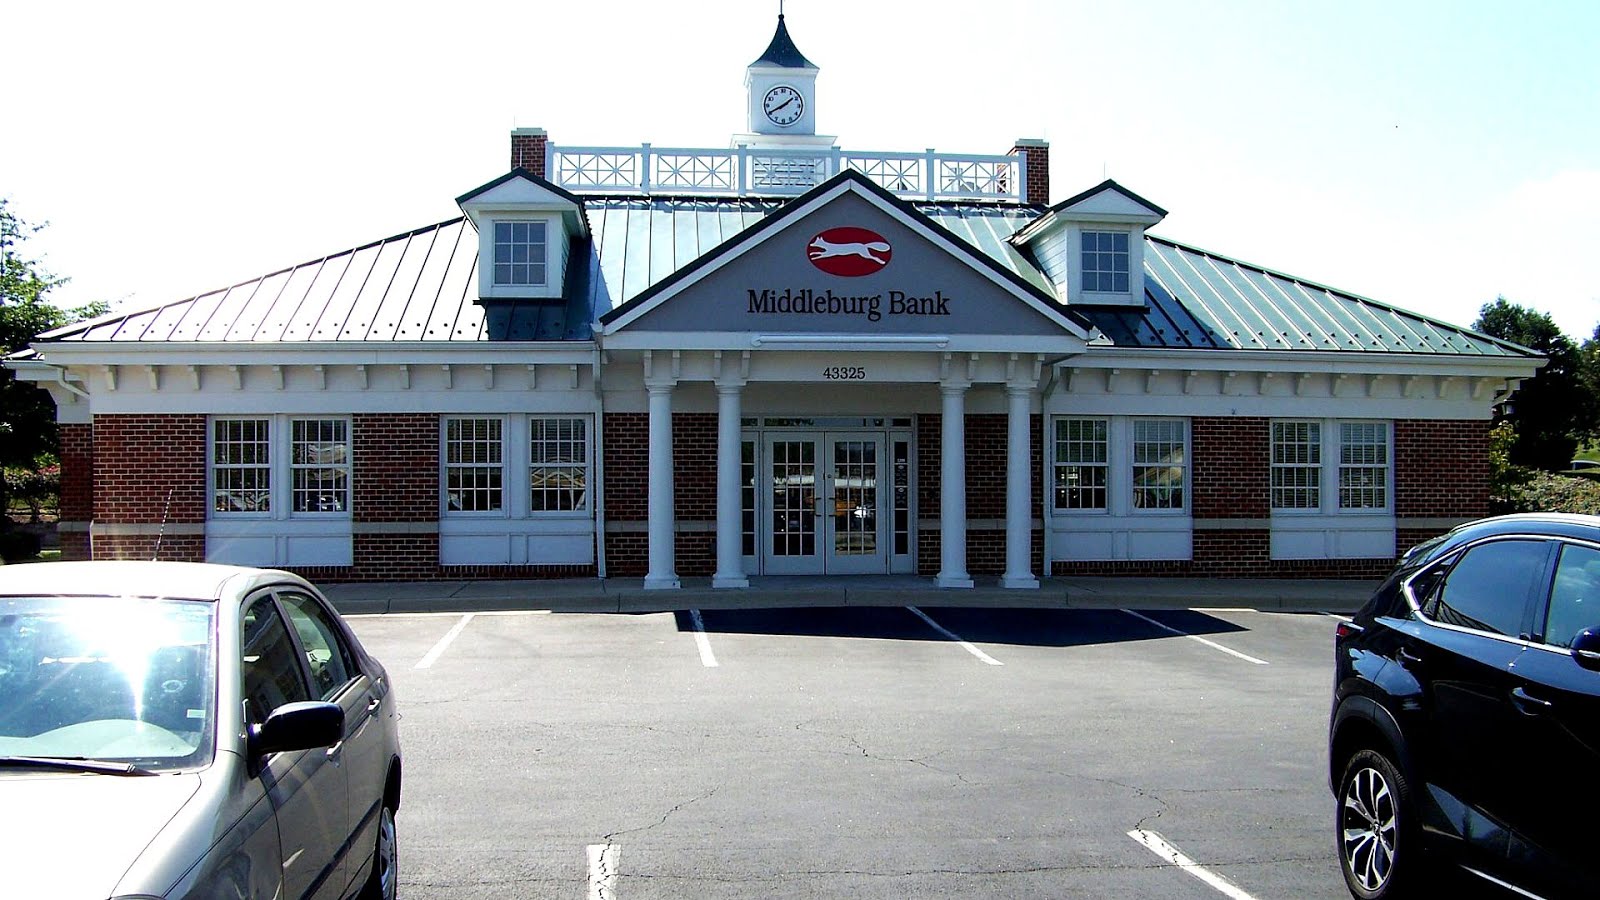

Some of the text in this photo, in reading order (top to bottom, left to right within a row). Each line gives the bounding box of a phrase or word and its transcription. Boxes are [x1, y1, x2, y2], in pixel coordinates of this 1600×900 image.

[747, 288, 951, 322] Middleburg Bank
[822, 367, 866, 380] 43325
